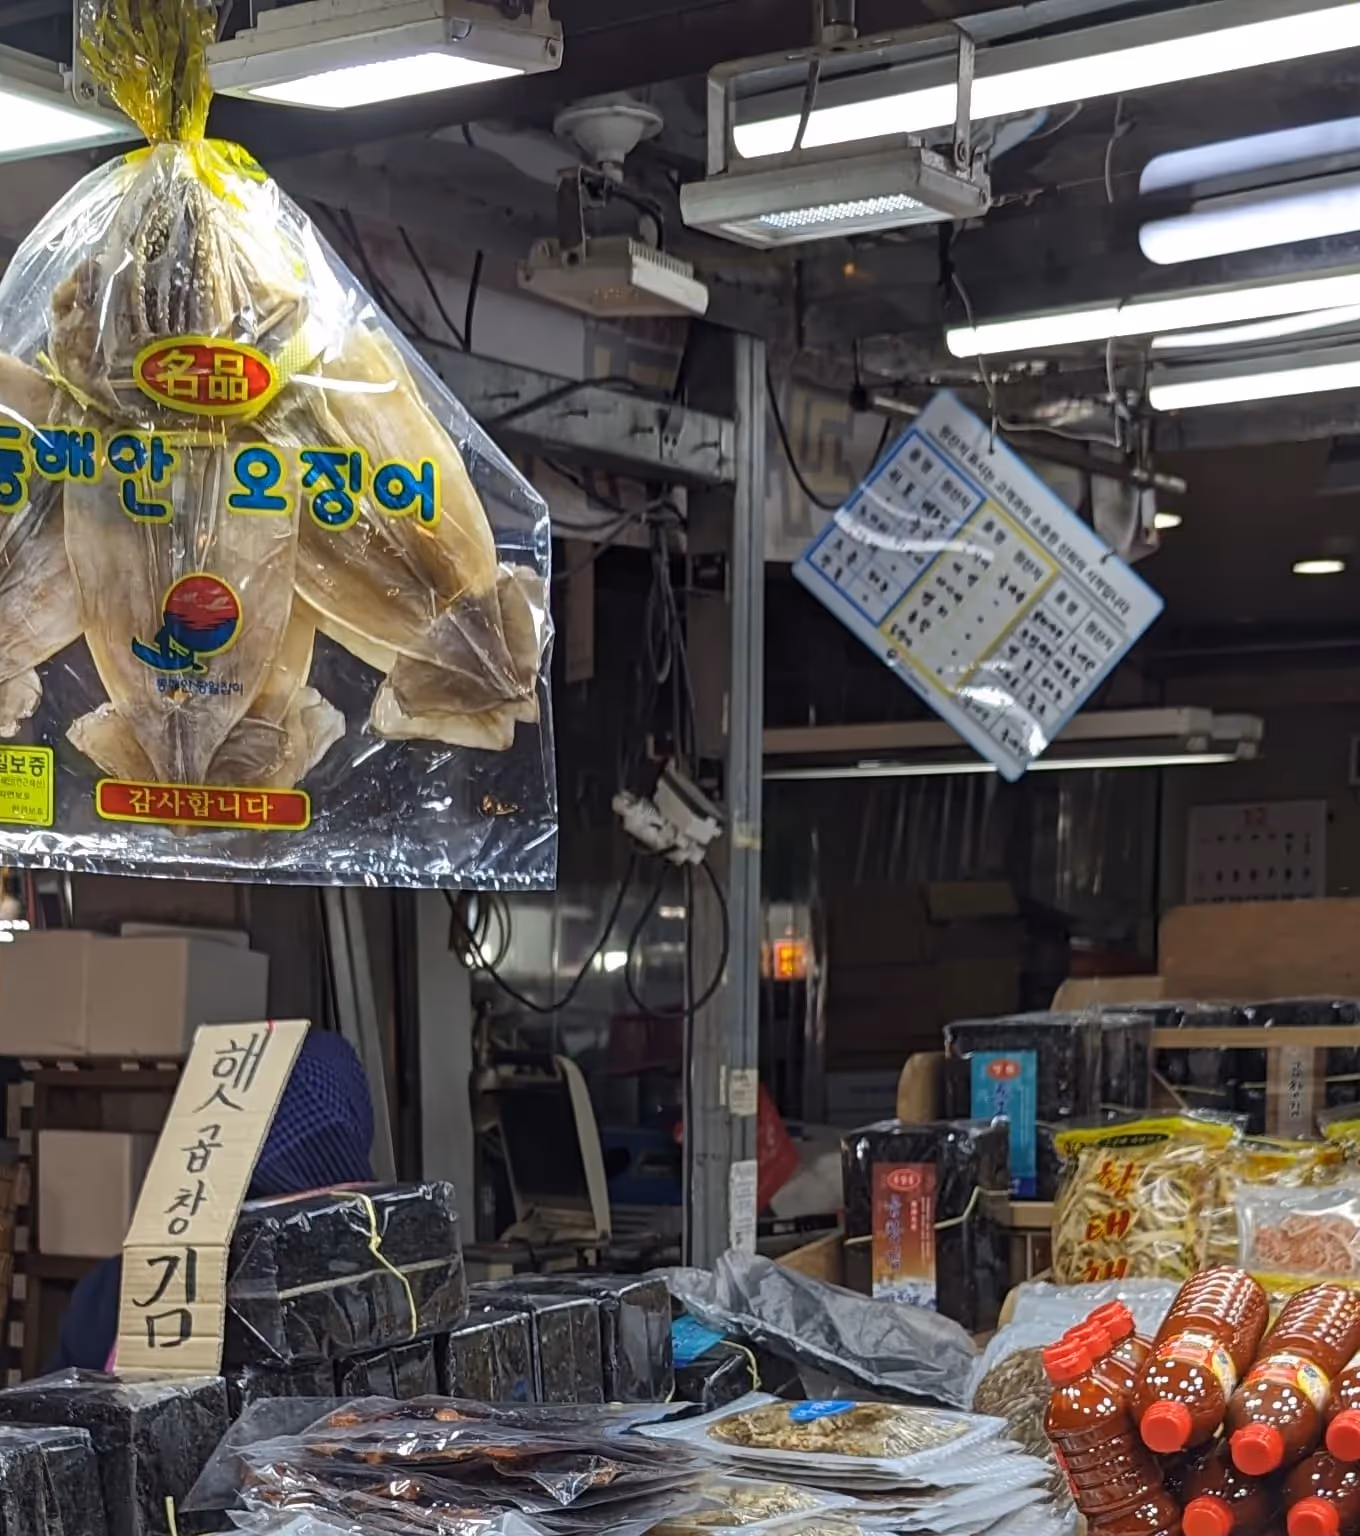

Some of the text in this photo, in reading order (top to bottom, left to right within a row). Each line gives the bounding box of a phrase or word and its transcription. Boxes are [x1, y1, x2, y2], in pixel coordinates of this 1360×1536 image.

[156, 348, 252, 402] 名品
[228, 444, 440, 530] 오징어
[129, 788, 274, 821] 감사합니다
[192, 1029, 275, 1113] 햇
[132, 1246, 198, 1350] 김
